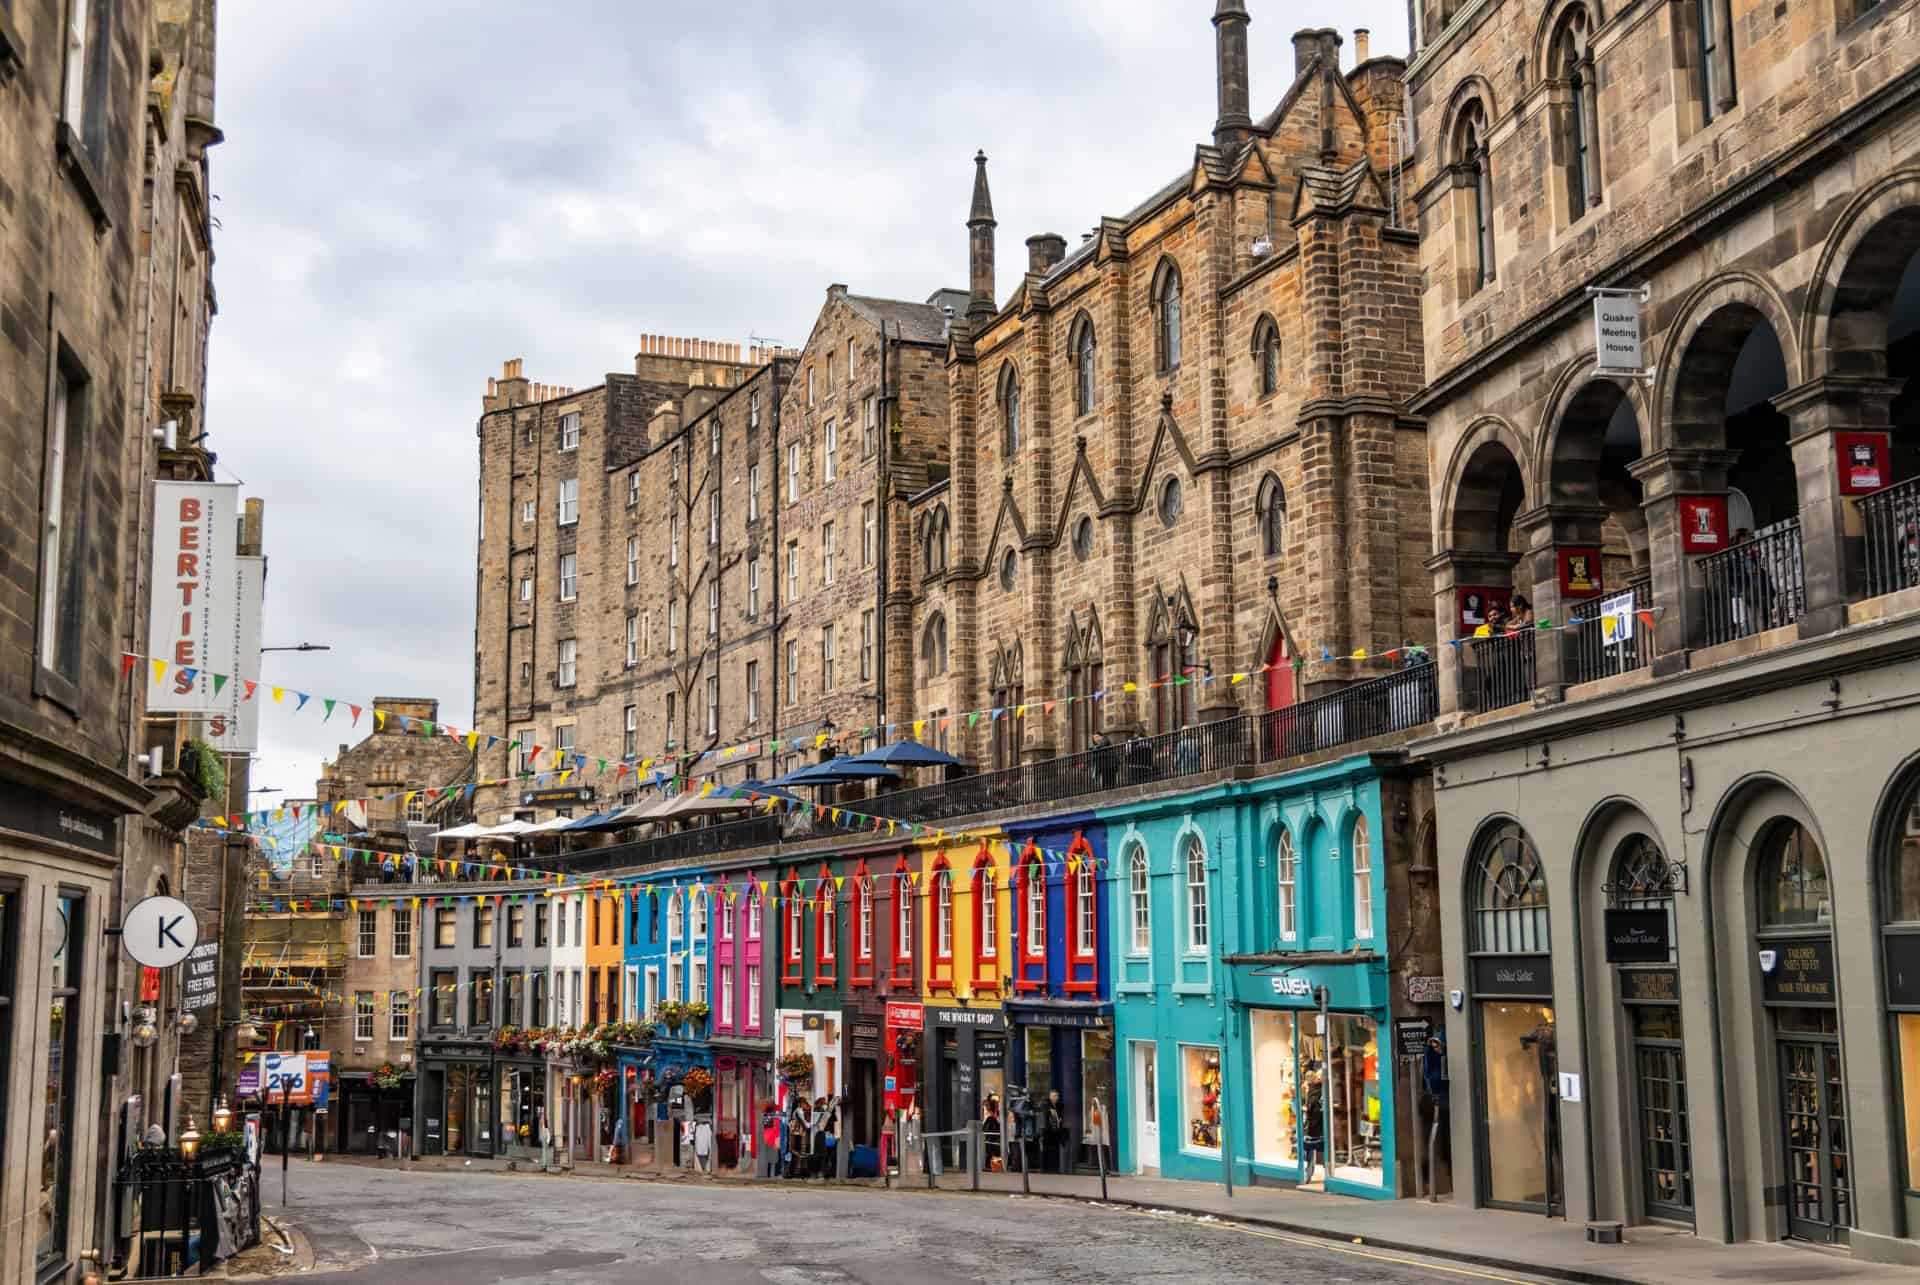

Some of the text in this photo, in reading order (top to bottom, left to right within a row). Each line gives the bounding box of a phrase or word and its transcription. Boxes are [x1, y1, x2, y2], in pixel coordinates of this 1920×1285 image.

[1602, 312, 1635, 322] Quaker
[1602, 328, 1637, 339] Meeting
[1606, 343, 1634, 352] House
[174, 498, 201, 694] BERTIES
[201, 607, 209, 667] RESTAURANT
[158, 915, 185, 948] K
[1271, 977, 1312, 994] SWISH
[938, 1011, 994, 1024] THE WHISKY SHOP
